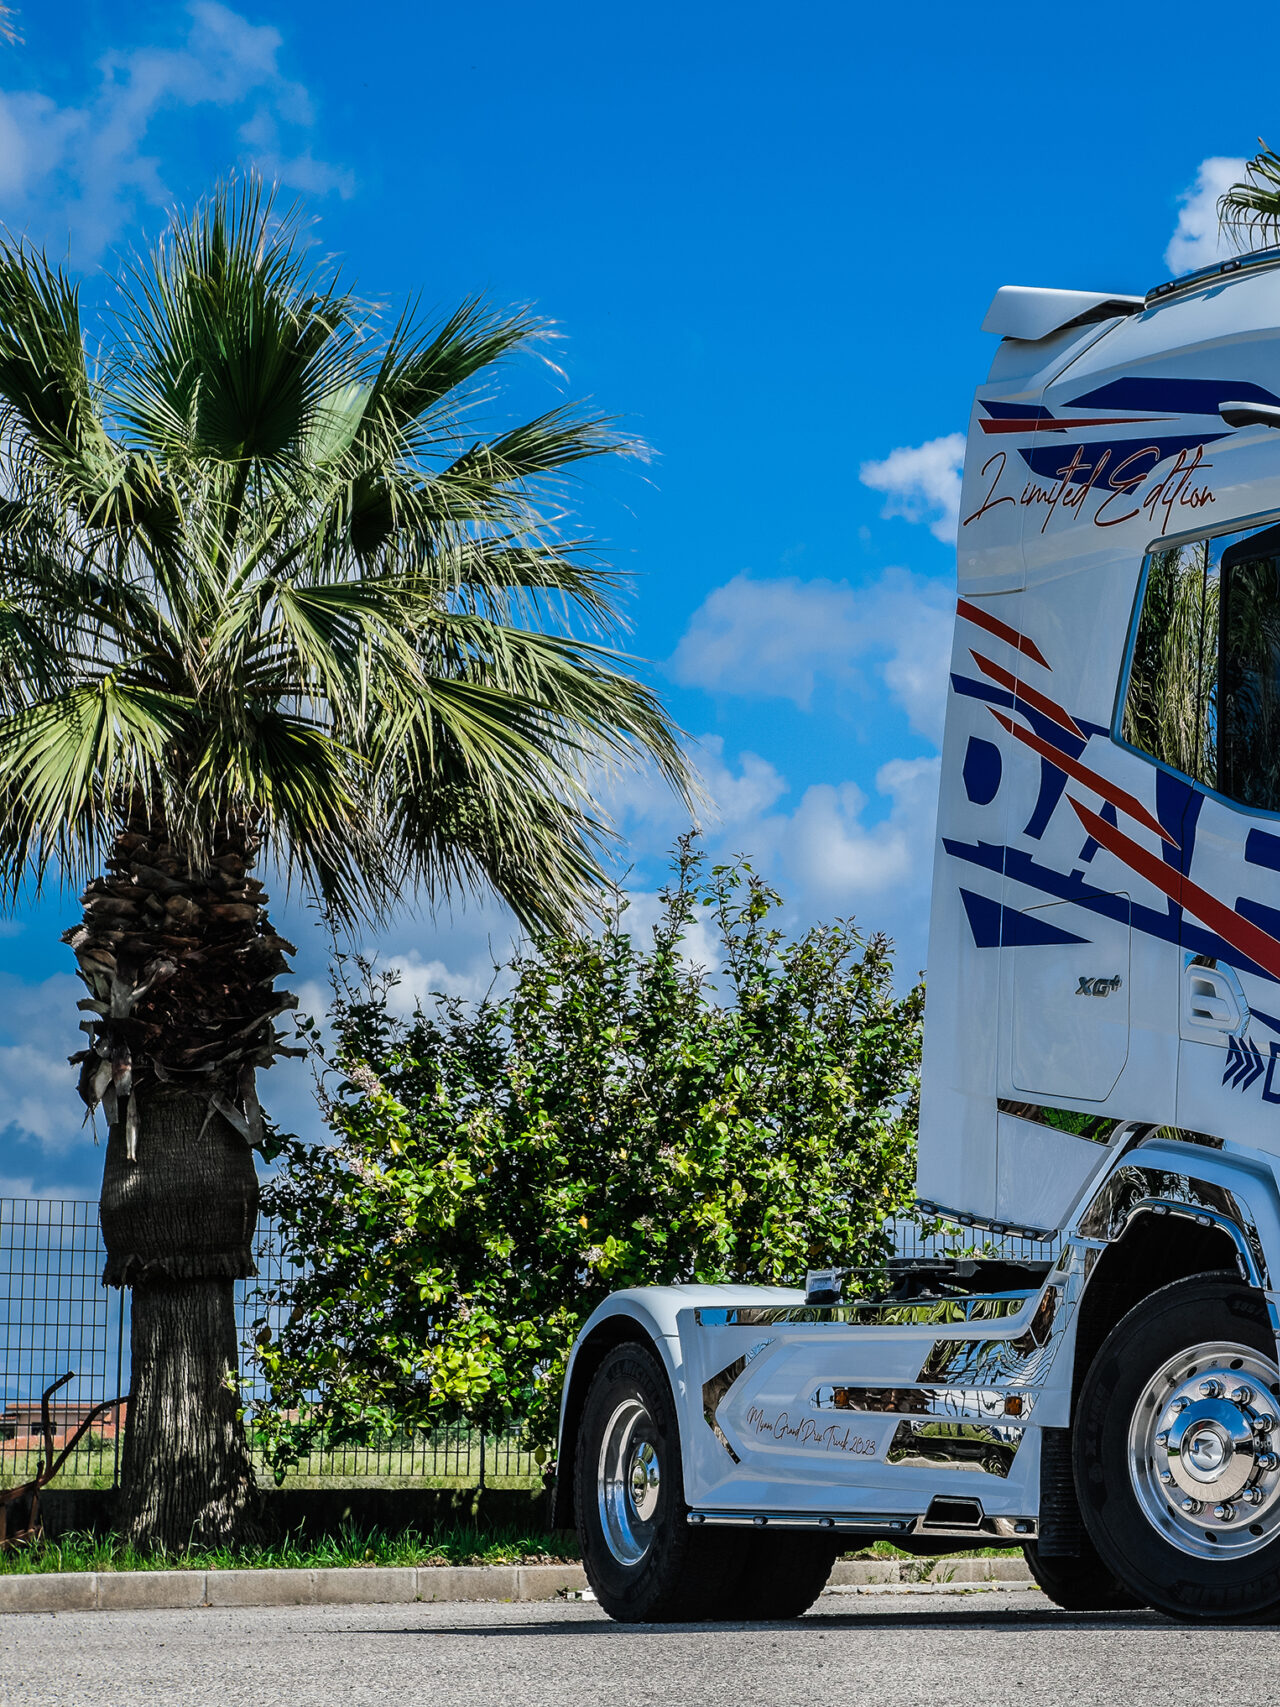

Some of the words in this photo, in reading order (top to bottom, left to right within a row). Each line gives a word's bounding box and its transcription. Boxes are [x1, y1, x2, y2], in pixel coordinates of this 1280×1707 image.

[963, 444, 1111, 534] Limited
[1094, 444, 1216, 535] Edition
[849, 1436, 876, 1455] 2023
